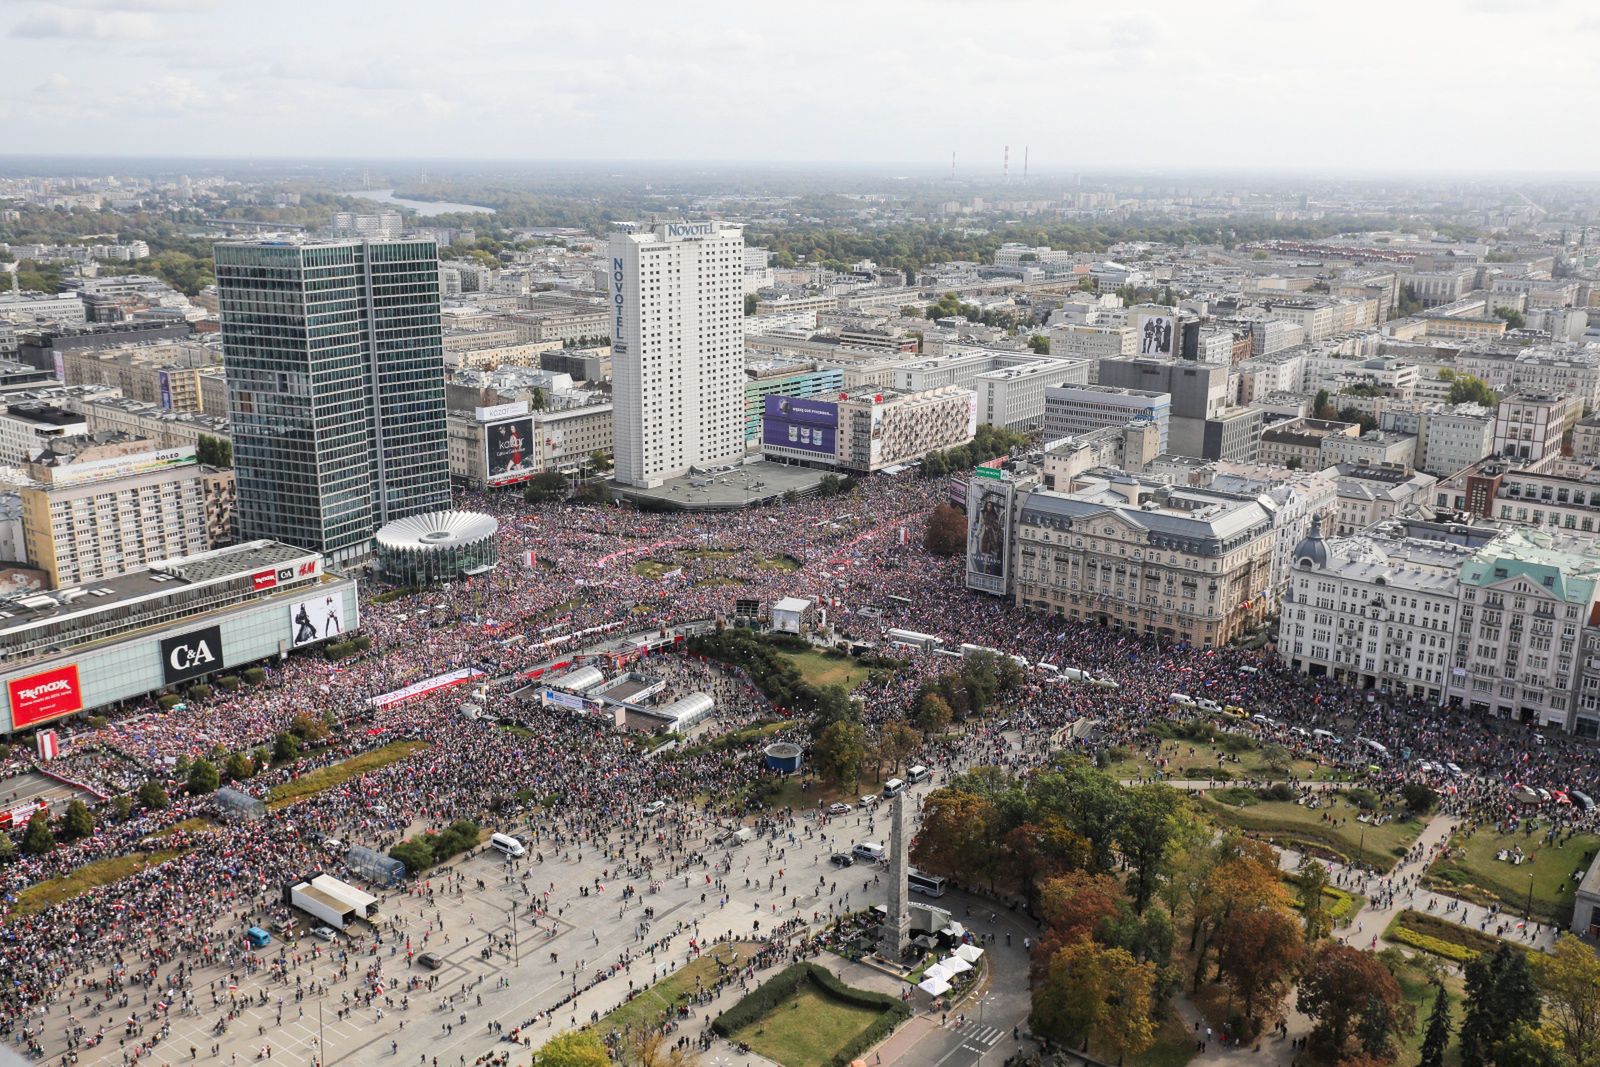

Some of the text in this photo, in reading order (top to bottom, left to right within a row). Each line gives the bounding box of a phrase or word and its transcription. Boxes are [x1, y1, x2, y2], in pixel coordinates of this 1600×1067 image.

[669, 222, 716, 237] NOVOTEL
[613, 257, 625, 340] NOVOTEL
[170, 639, 216, 671] C&A
